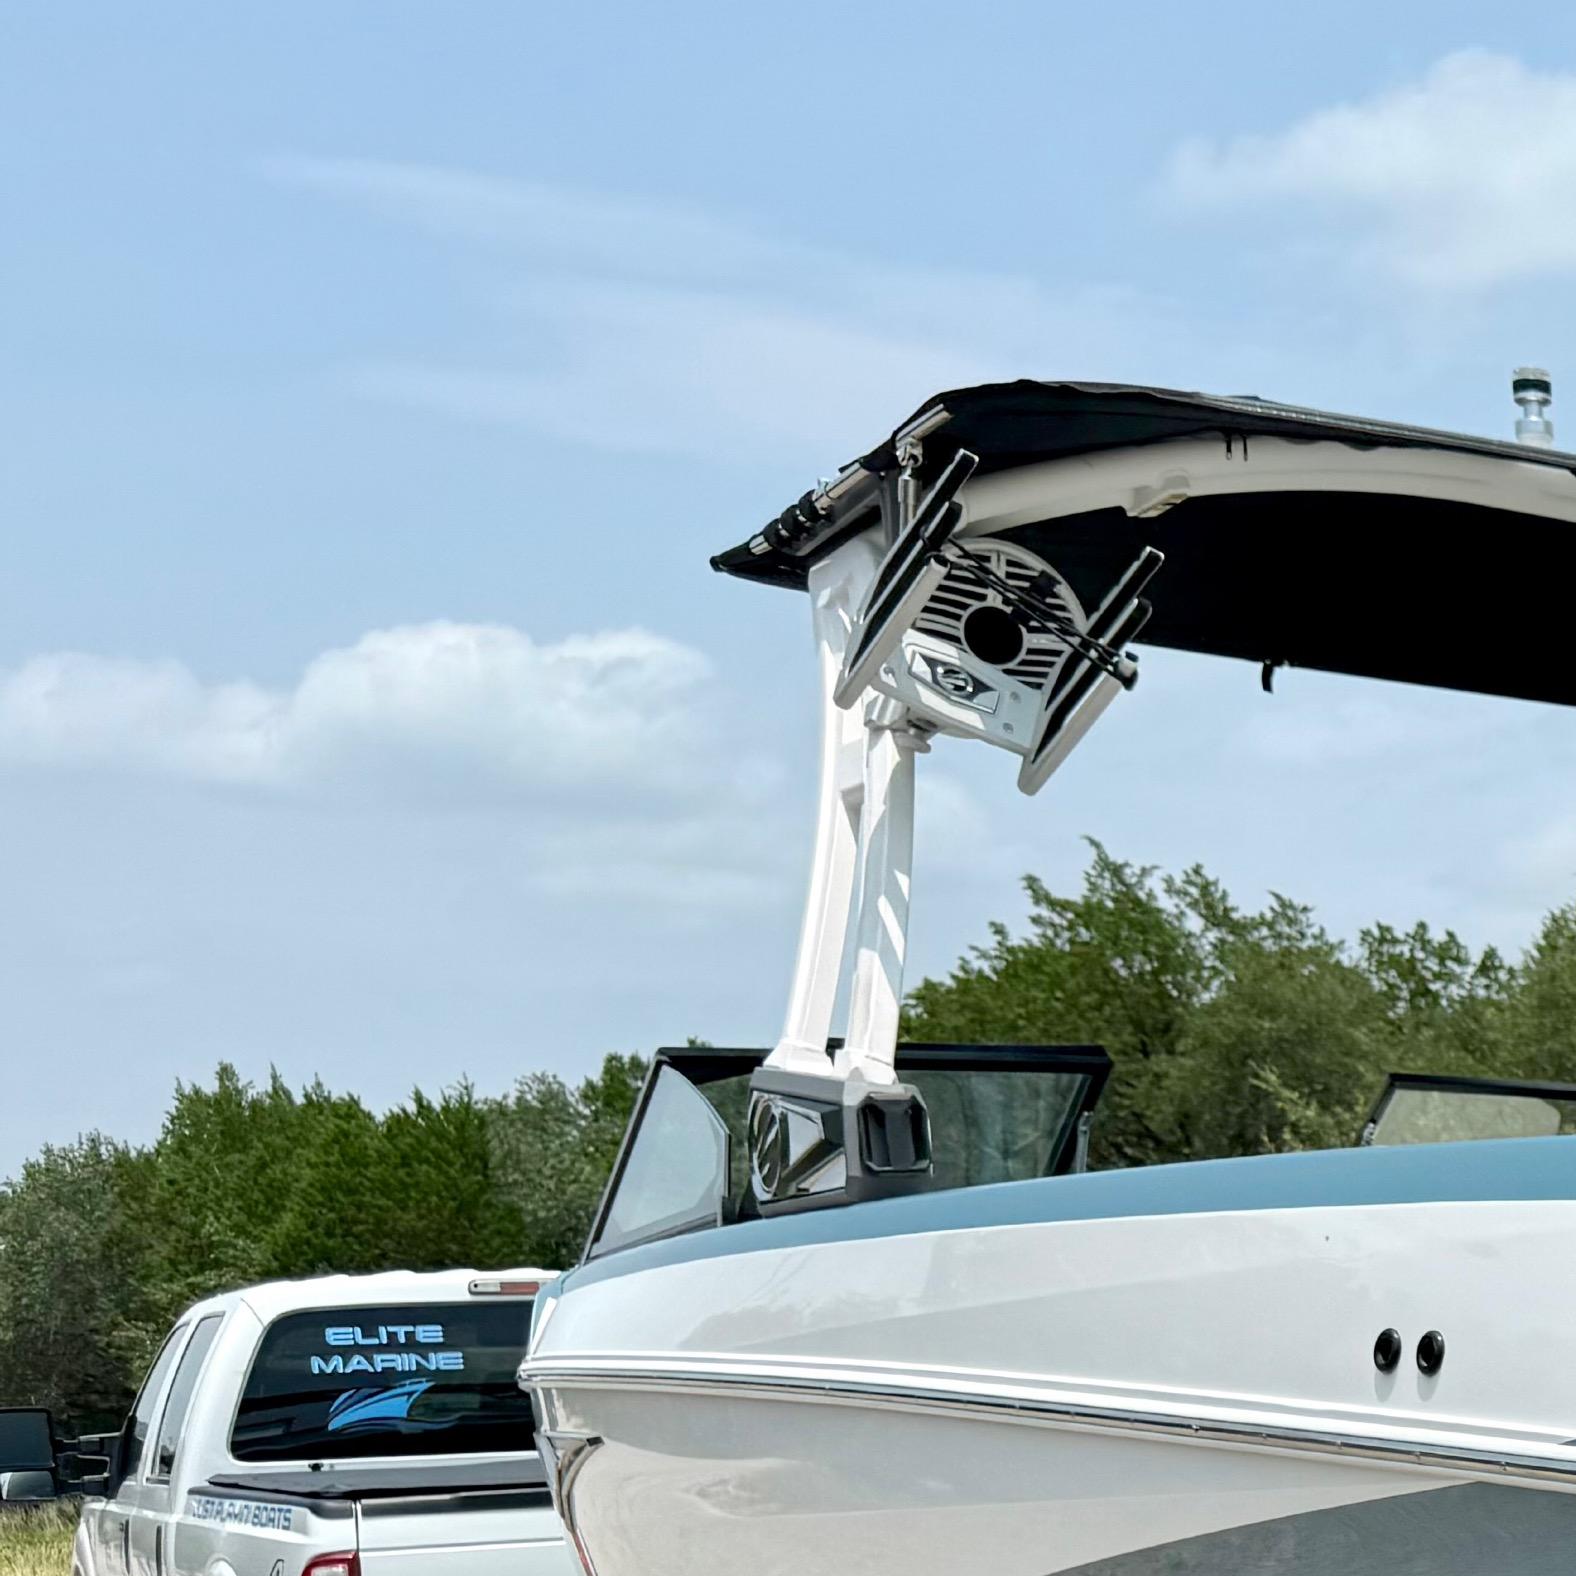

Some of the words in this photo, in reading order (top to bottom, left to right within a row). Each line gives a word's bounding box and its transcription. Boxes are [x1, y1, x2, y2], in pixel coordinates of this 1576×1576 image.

[325, 1324, 444, 1346] ELITE
[310, 1351, 465, 1374] MARINE
[252, 1504, 293, 1531] BOATS
